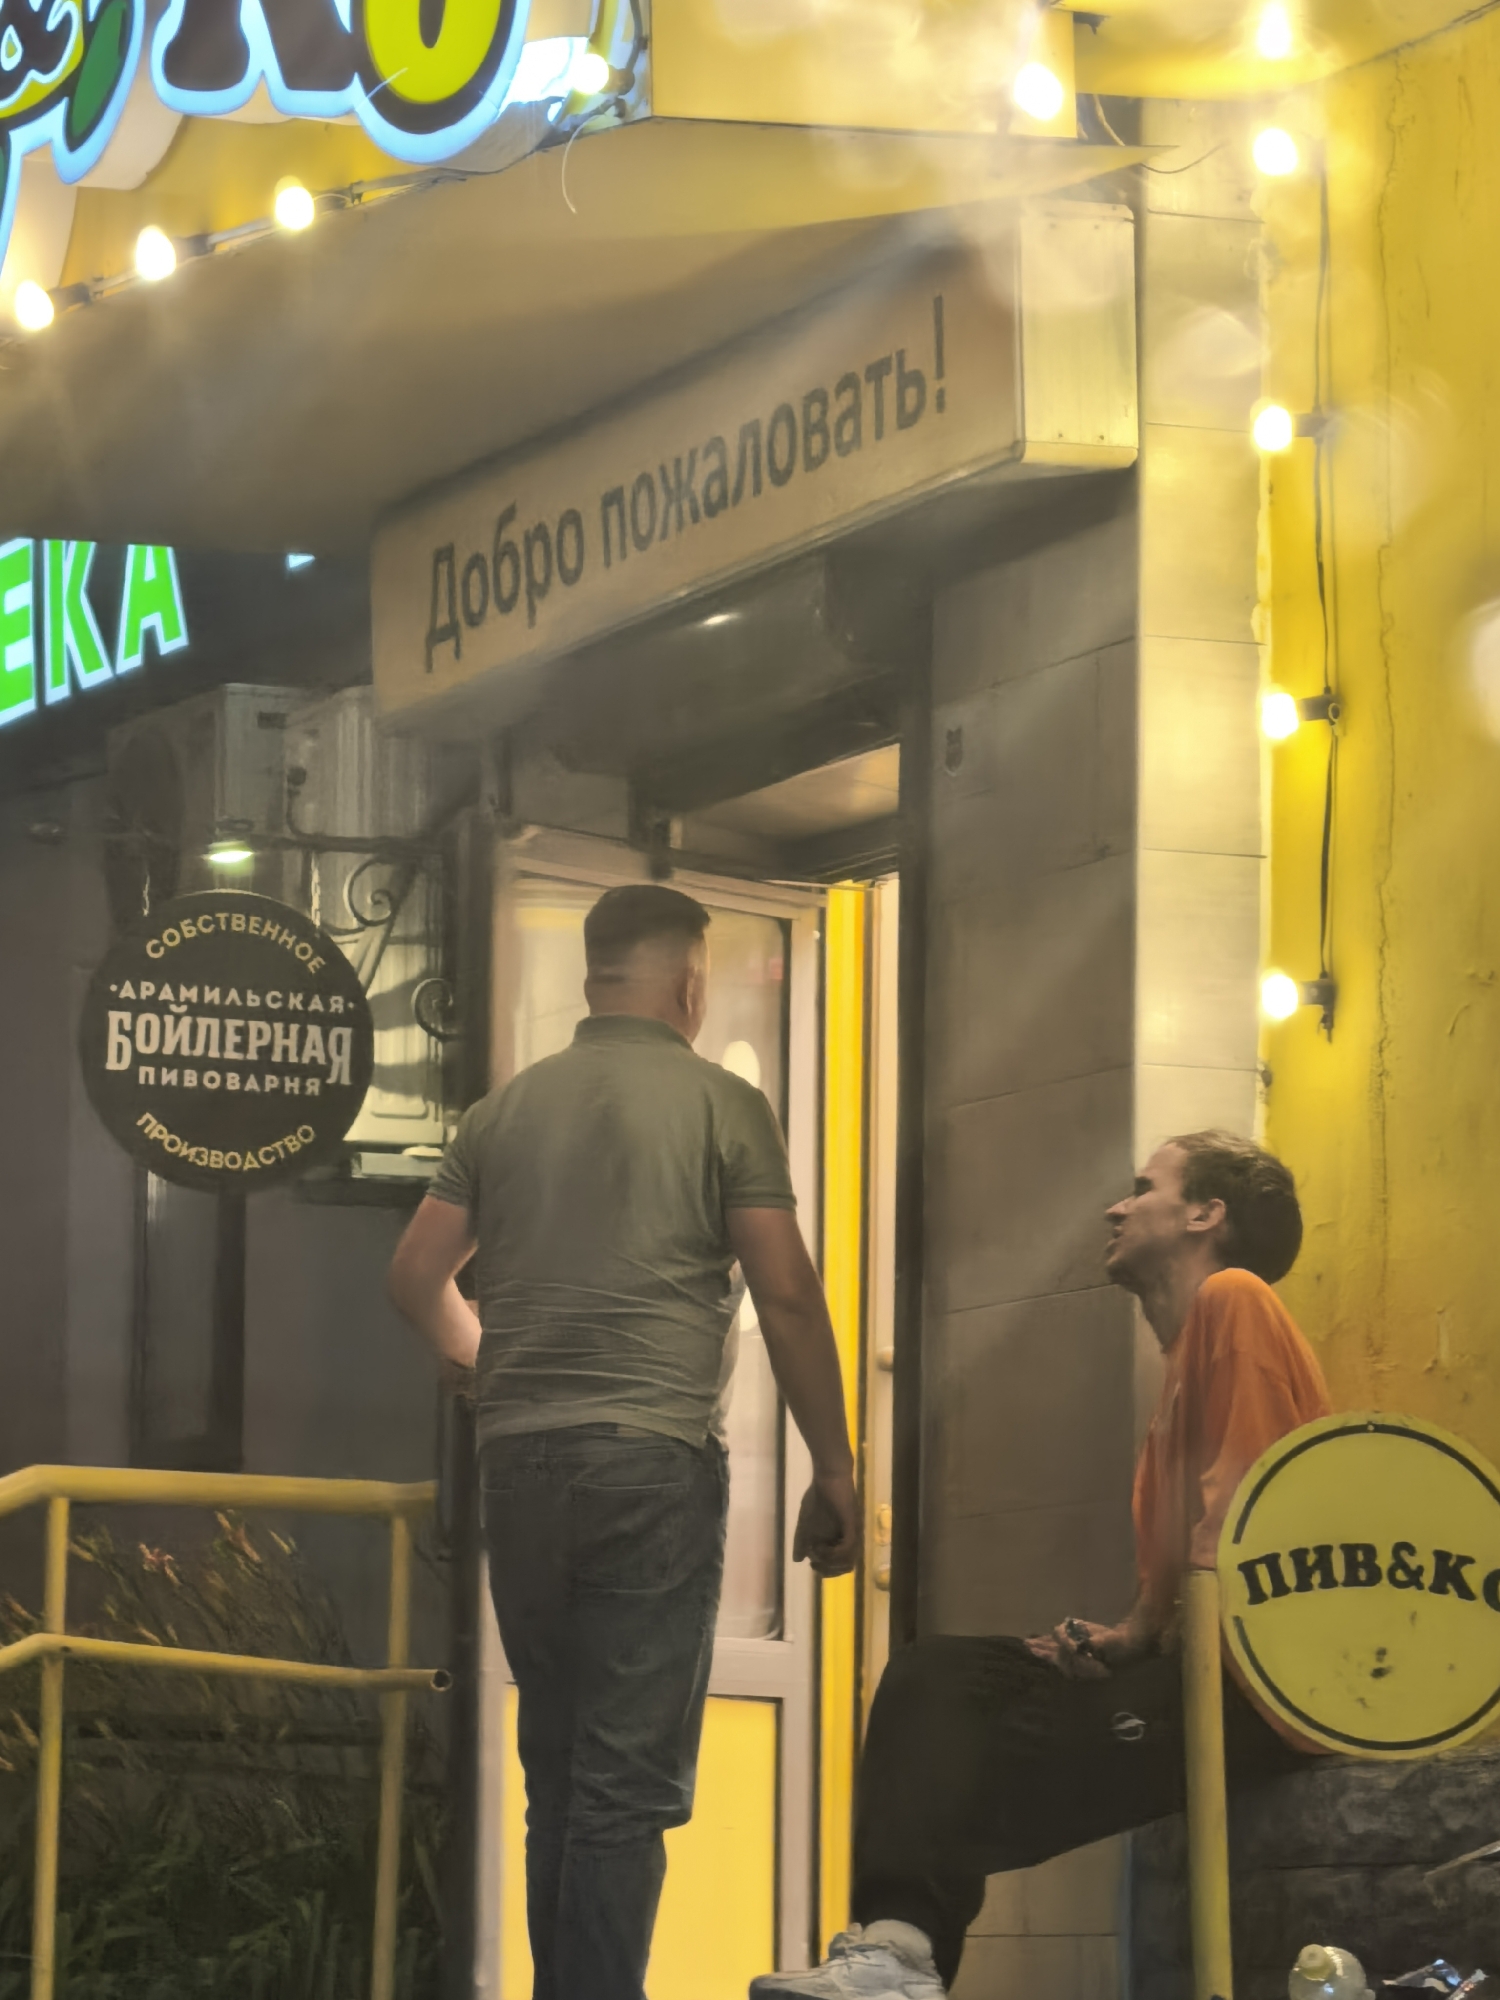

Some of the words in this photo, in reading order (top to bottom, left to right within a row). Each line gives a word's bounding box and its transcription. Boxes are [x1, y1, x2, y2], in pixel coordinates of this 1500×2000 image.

[424, 500, 585, 673] Добро
[600, 294, 946, 569] пожаловать!
[145, 912, 326, 974] СОБСТВЕННОЕ
[105, 1004, 353, 1085] БОЙЛЕРНАЯ
[138, 1066, 321, 1096] ПИВОВАРНЯ
[136, 1112, 315, 1171] ПРОИЗВОДСТВО
